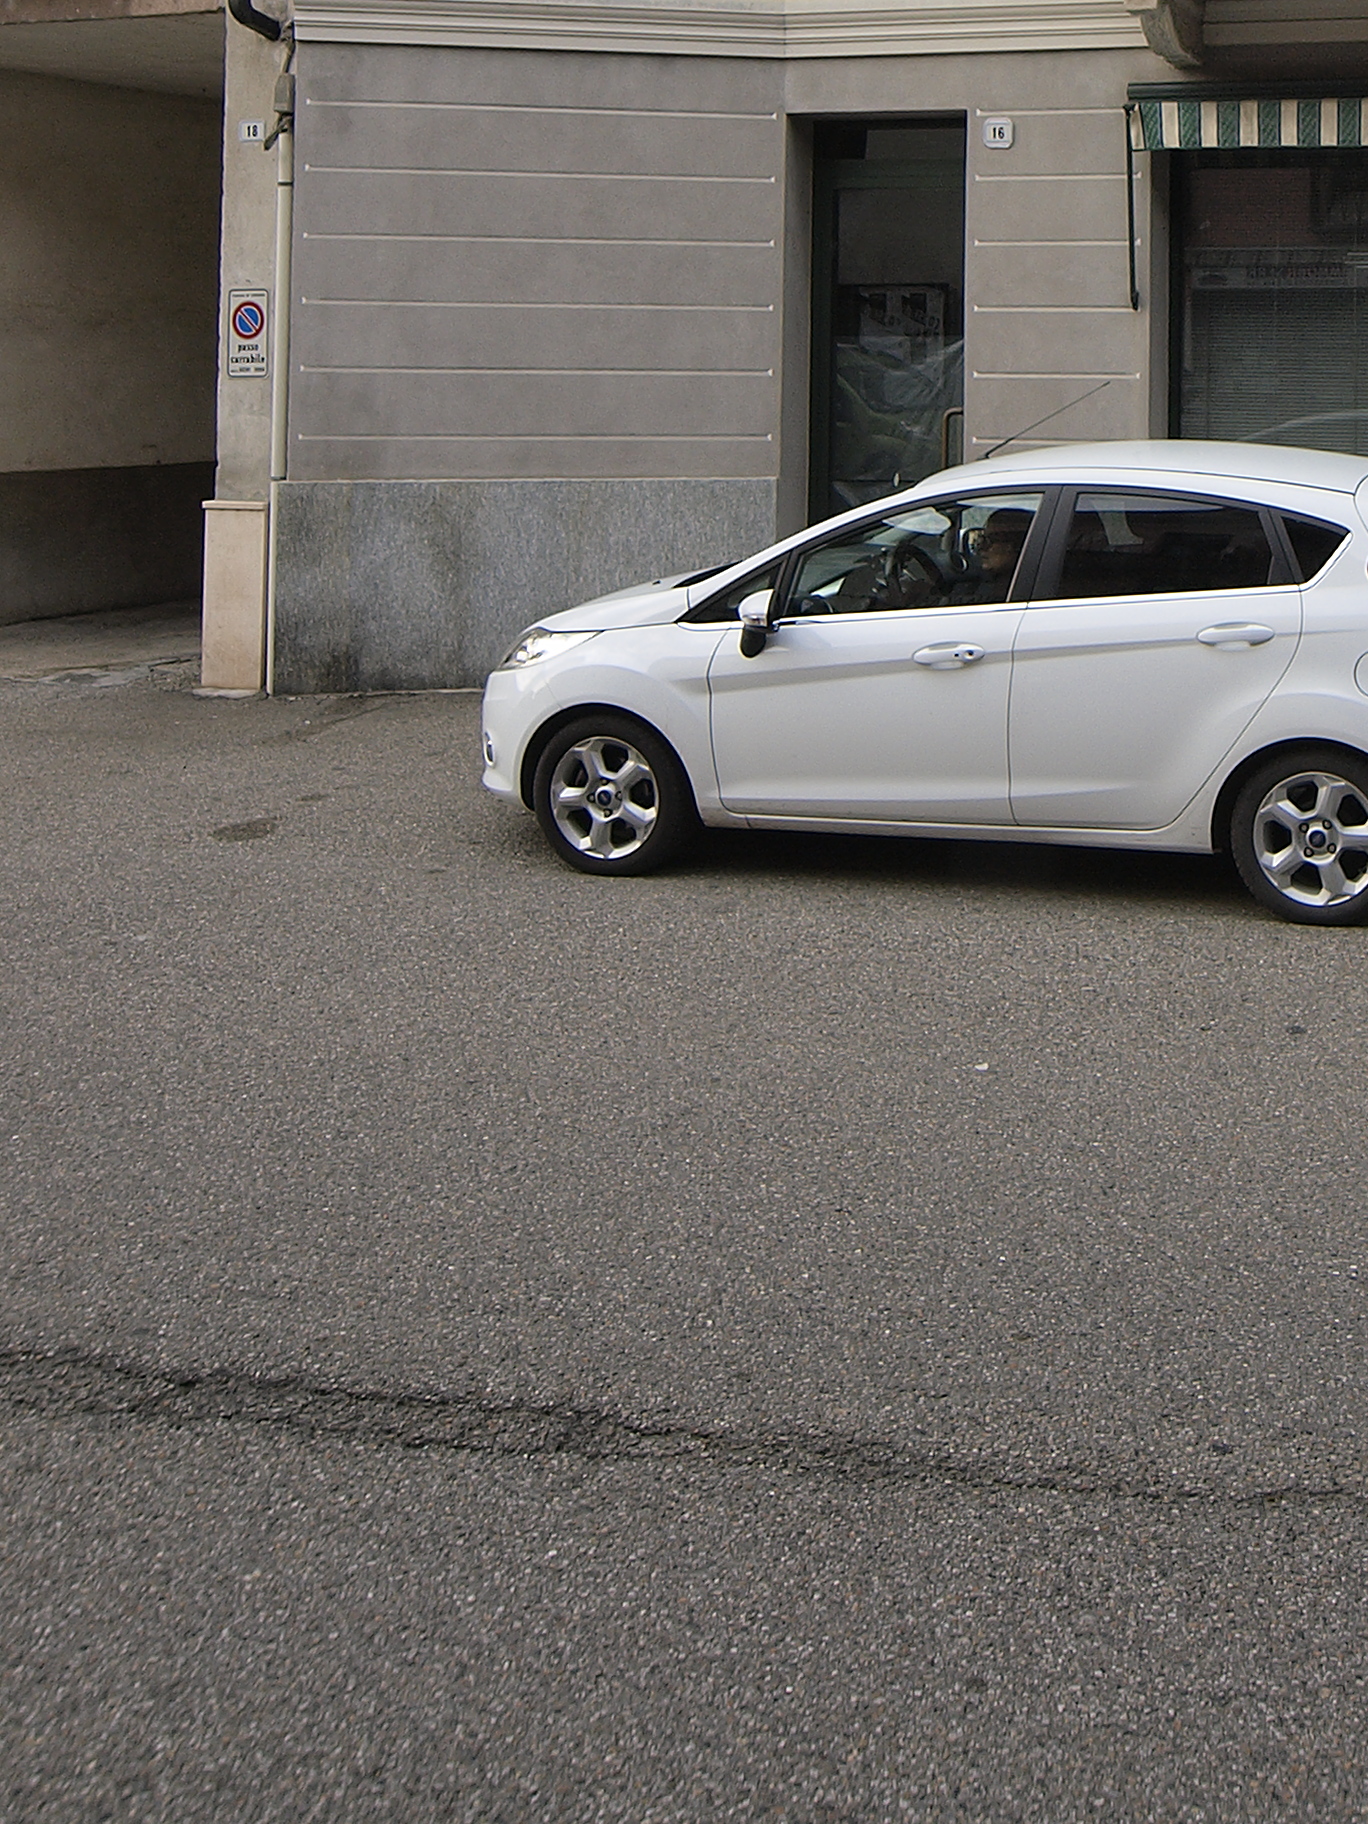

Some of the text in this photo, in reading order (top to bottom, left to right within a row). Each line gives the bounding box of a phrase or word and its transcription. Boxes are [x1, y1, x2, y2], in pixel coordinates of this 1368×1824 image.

[247, 125, 258, 137] 18
[992, 126, 1005, 139] 16
[230, 353, 265, 363] carrabile
